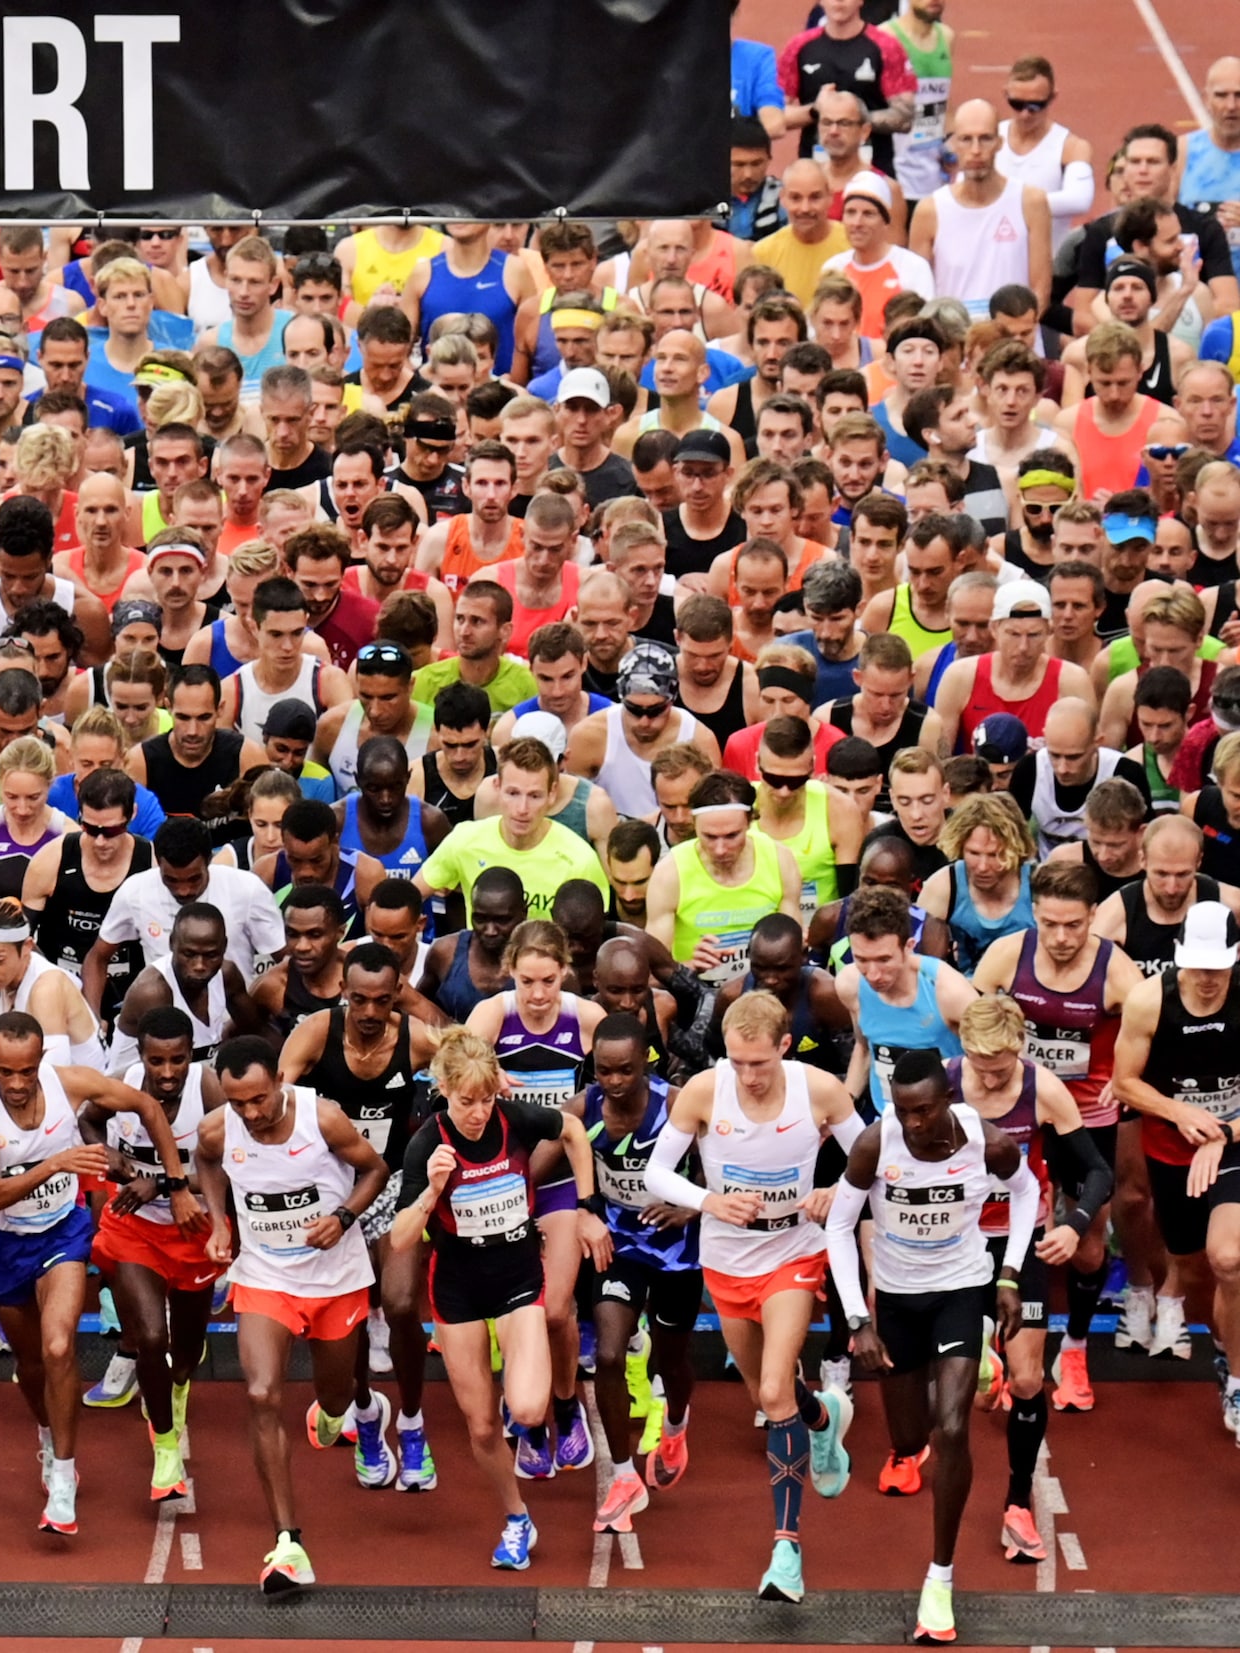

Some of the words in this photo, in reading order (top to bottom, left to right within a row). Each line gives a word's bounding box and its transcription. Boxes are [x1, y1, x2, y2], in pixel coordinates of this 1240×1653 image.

[731, 963, 745, 973] 49
[1056, 1028, 1081, 1042] tcs
[1027, 1043, 1075, 1061] PACER
[360, 1105, 385, 1119] tcs
[461, 1159, 511, 1180] saucony
[622, 1156, 648, 1170] tcs
[605, 1172, 647, 1192] PACER
[283, 1192, 311, 1209] tcs
[618, 1192, 632, 1202] 96
[928, 1188, 955, 1203] tcs
[36, 1200, 50, 1210] 36
[479, 1193, 526, 1218] MEIJDEN
[768, 1217, 791, 1231] tcs
[899, 1211, 950, 1226] PACER
[286, 1234, 293, 1243] 2
[504, 1226, 527, 1243] tcs
[917, 1227, 931, 1236] 87
